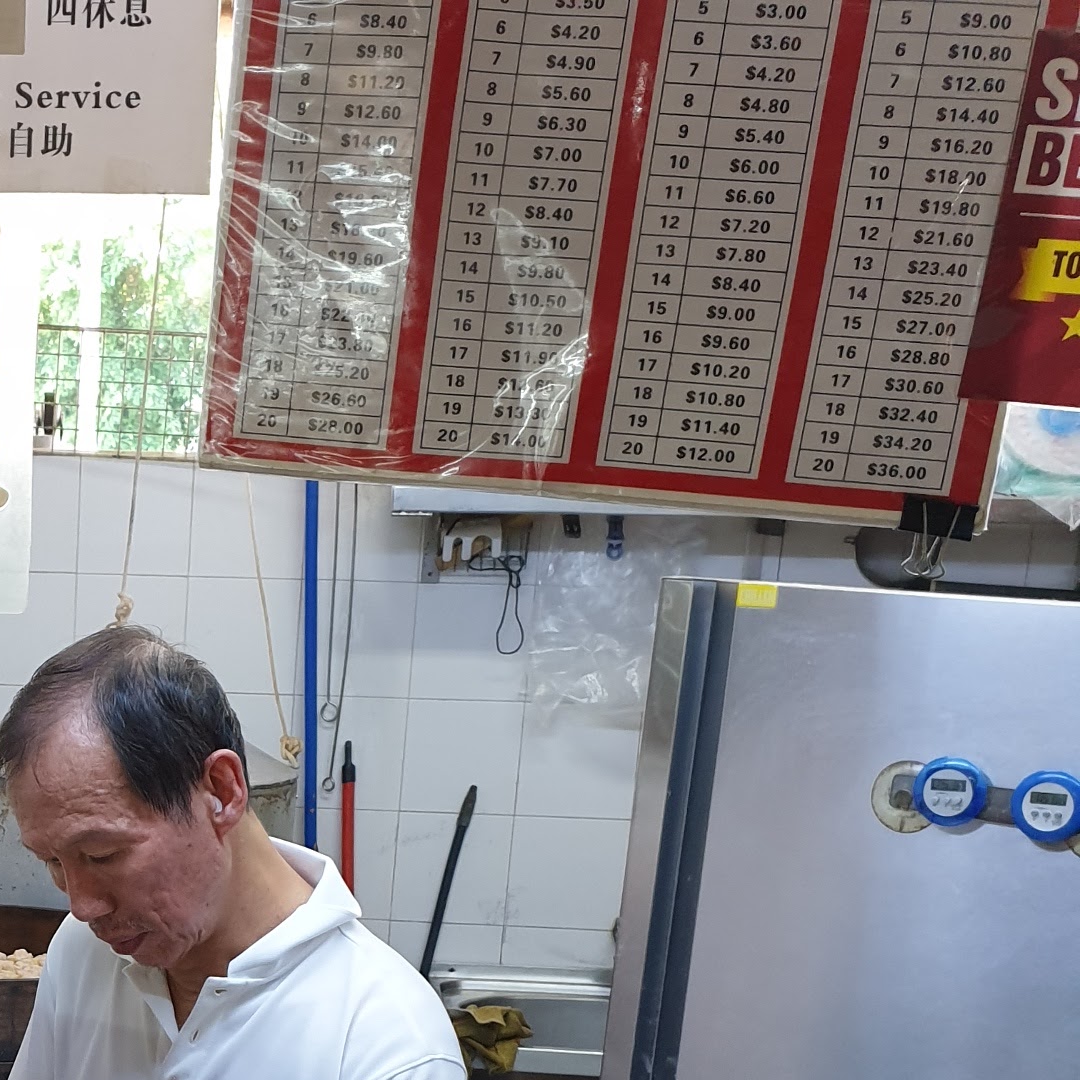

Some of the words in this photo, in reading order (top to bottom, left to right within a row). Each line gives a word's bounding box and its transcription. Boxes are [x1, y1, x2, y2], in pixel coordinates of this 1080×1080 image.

[698, 0, 709, 15] 5
[755, 3, 807, 20] $3.00
[900, 9, 912, 26] 5
[959, 12, 1012, 31] $9.00
[359, 13, 408, 30] $8.40
[495, 20, 507, 35] 6
[550, 24, 601, 41] $4.20
[304, 42, 314, 57] 7
[356, 43, 403, 60] $9.80
[693, 31, 705, 46] 6
[750, 34, 802, 52] $3.60
[895, 42, 907, 57] 6
[947, 43, 1012, 62] $10.80
[492, 50, 502, 66] 7
[546, 54, 596, 71] $4.90
[300, 72, 311, 87] 8
[348, 74, 406, 90] $11.20
[689, 62, 699, 77] 7
[745, 65, 796, 84] $4.20
[890, 73, 900, 89] 7
[941, 74, 1005, 93] $12.60
[14, 81, 142, 110] Service
[486, 81, 498, 96] 8
[541, 84, 592, 102] $5.60
[297, 101, 307, 116] 9
[343, 103, 401, 121] $12.60
[683, 93, 695, 108] 8
[739, 96, 790, 114] $4.80
[482, 112, 493, 127] 9
[537, 115, 587, 133] $6.30
[883, 104, 895, 120] 8
[935, 106, 1000, 125] $14.40
[678, 124, 689, 139] 9
[734, 127, 785, 145] $5.40
[474, 142, 494, 157] 10
[533, 145, 582, 163] $7.00
[878, 135, 890, 150] 9
[930, 137, 993, 156] $16.20
[287, 159, 304, 175] 11
[669, 154, 690, 170] 10
[729, 158, 780, 175] $6.00
[471, 172, 489, 187] 11
[528, 175, 578, 193] $7.70
[869, 165, 890, 181] 10
[924, 168, 987, 187] $18.00
[665, 185, 684, 200] 11
[724, 188, 775, 205] $6.60
[467, 202, 486, 217] 12
[524, 205, 574, 222] $8.40
[864, 195, 884, 211] 11
[919, 198, 980, 217] $19.80
[660, 214, 680, 230] 12
[720, 217, 771, 234] $7.20
[463, 231, 482, 246] 13
[520, 235, 570, 251] $9.10
[859, 225, 880, 241] 12
[912, 228, 974, 248] $21.60
[656, 243, 676, 258] 13
[715, 246, 766, 264] $7.80
[460, 260, 479, 275] 14
[517, 264, 566, 281] $9.80
[853, 255, 874, 271] 13
[907, 259, 968, 278] $23.40
[651, 272, 671, 287] 14
[711, 275, 761, 293] $8.40
[456, 289, 475, 304] 15
[507, 292, 567, 308] $10.50
[848, 285, 868, 301] 14
[901, 289, 962, 308] $25.20
[647, 300, 667, 315] 15
[706, 305, 756, 322] $9.00
[453, 317, 472, 332] 16
[504, 320, 563, 338] $11.20
[842, 315, 862, 330] 15
[896, 319, 956, 337] $27.00
[643, 329, 663, 344] 16
[700, 334, 750, 351] $9.60
[449, 345, 469, 360] 17
[837, 344, 857, 360] 16
[890, 348, 950, 367] $28.80
[264, 358, 284, 373] 18
[638, 358, 658, 372] 17
[690, 362, 751, 380] $10.20
[446, 373, 465, 388] 18
[831, 373, 851, 388] 17
[884, 377, 944, 395] $30.60
[311, 390, 367, 408] $26.60
[633, 386, 653, 400] 18
[685, 390, 746, 408] $10.80
[443, 401, 462, 416] 19
[825, 402, 846, 417] 18
[878, 406, 938, 424] $32.40
[256, 414, 276, 429] 20
[307, 419, 364, 437] $28.00
[436, 428, 458, 443] 20
[628, 414, 648, 428] 19
[680, 418, 741, 436] $11.40
[820, 430, 840, 445] 19
[872, 434, 933, 452] $34.20
[621, 441, 644, 456] 20
[676, 445, 735, 464] $12.00
[812, 458, 835, 473] 20
[866, 462, 927, 480] $36.00
